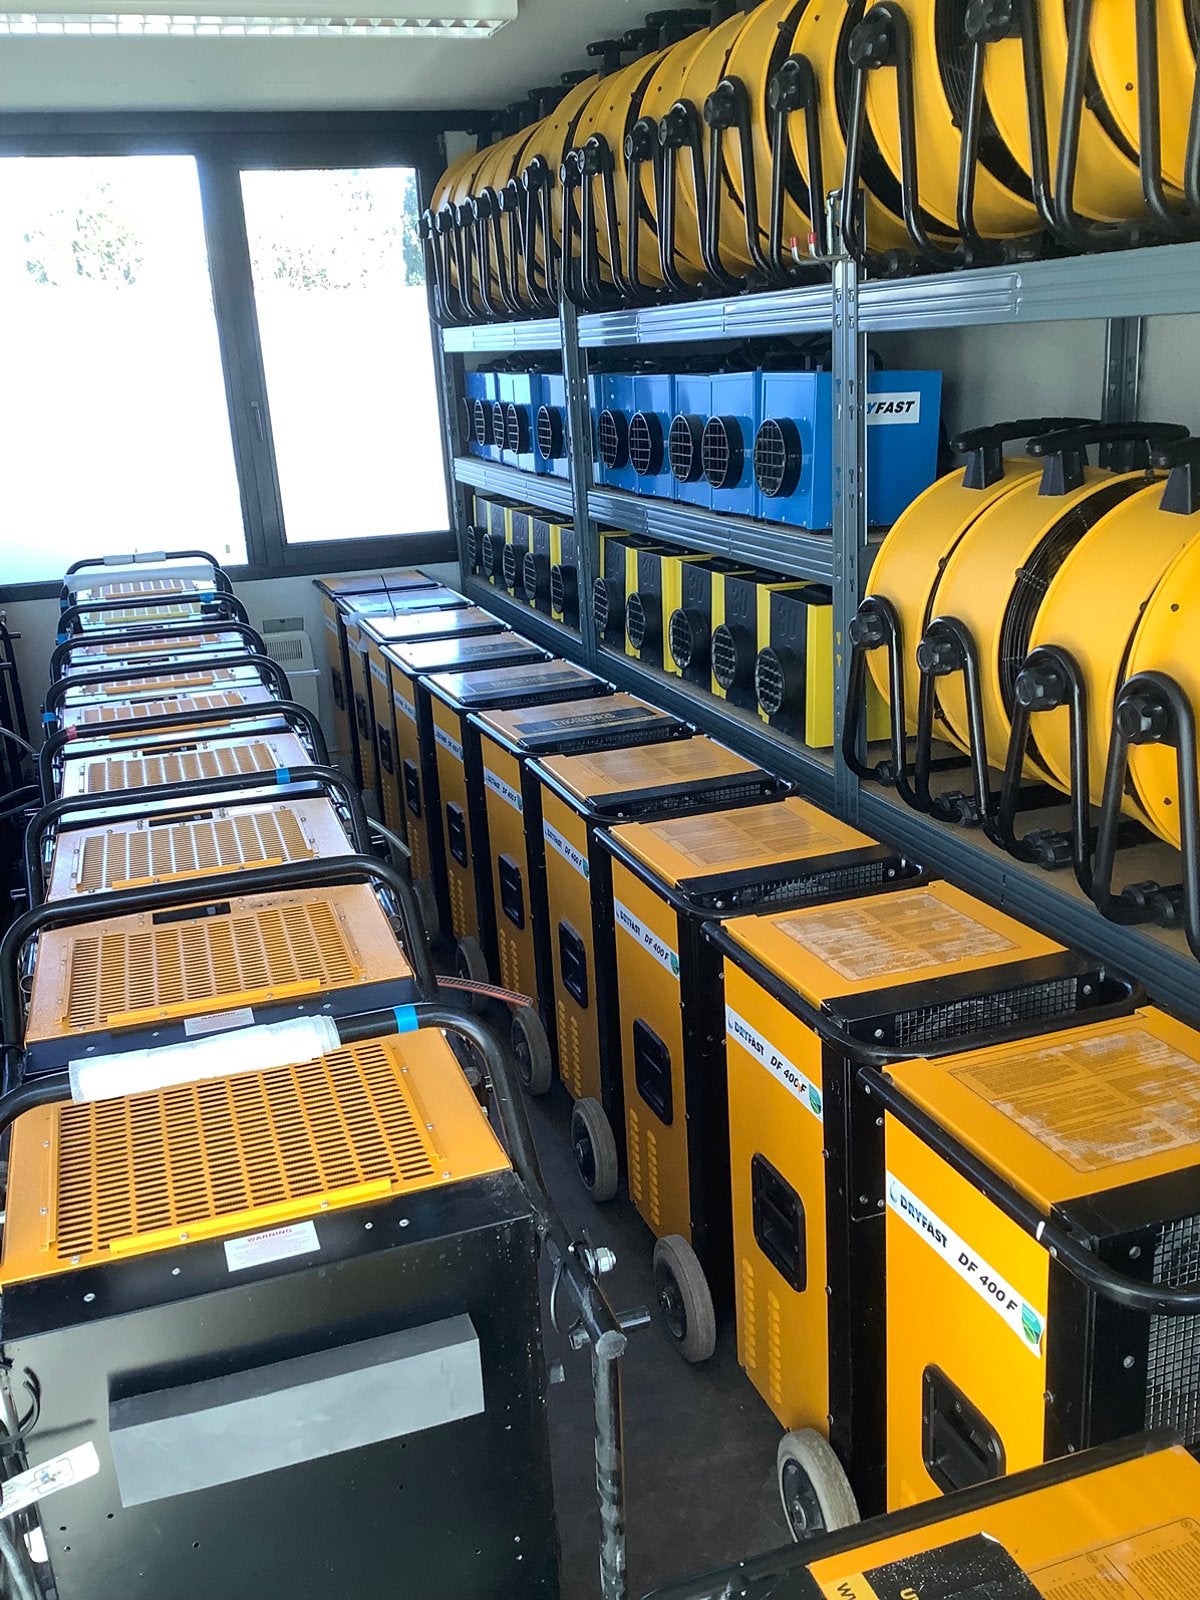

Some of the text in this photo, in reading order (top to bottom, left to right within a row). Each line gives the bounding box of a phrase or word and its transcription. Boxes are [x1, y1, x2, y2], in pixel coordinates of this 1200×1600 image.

[867, 401, 916, 414] YFAST
[644, 934, 653, 945] DF
[653, 944, 664, 957] 400
[770, 1055, 783, 1070] DF
[783, 1070, 799, 1088] 400
[800, 1084, 807, 1093] F
[247, 1228, 292, 1242] WARNING
[900, 1194, 1018, 1311] DRYFAST DF 400 F
